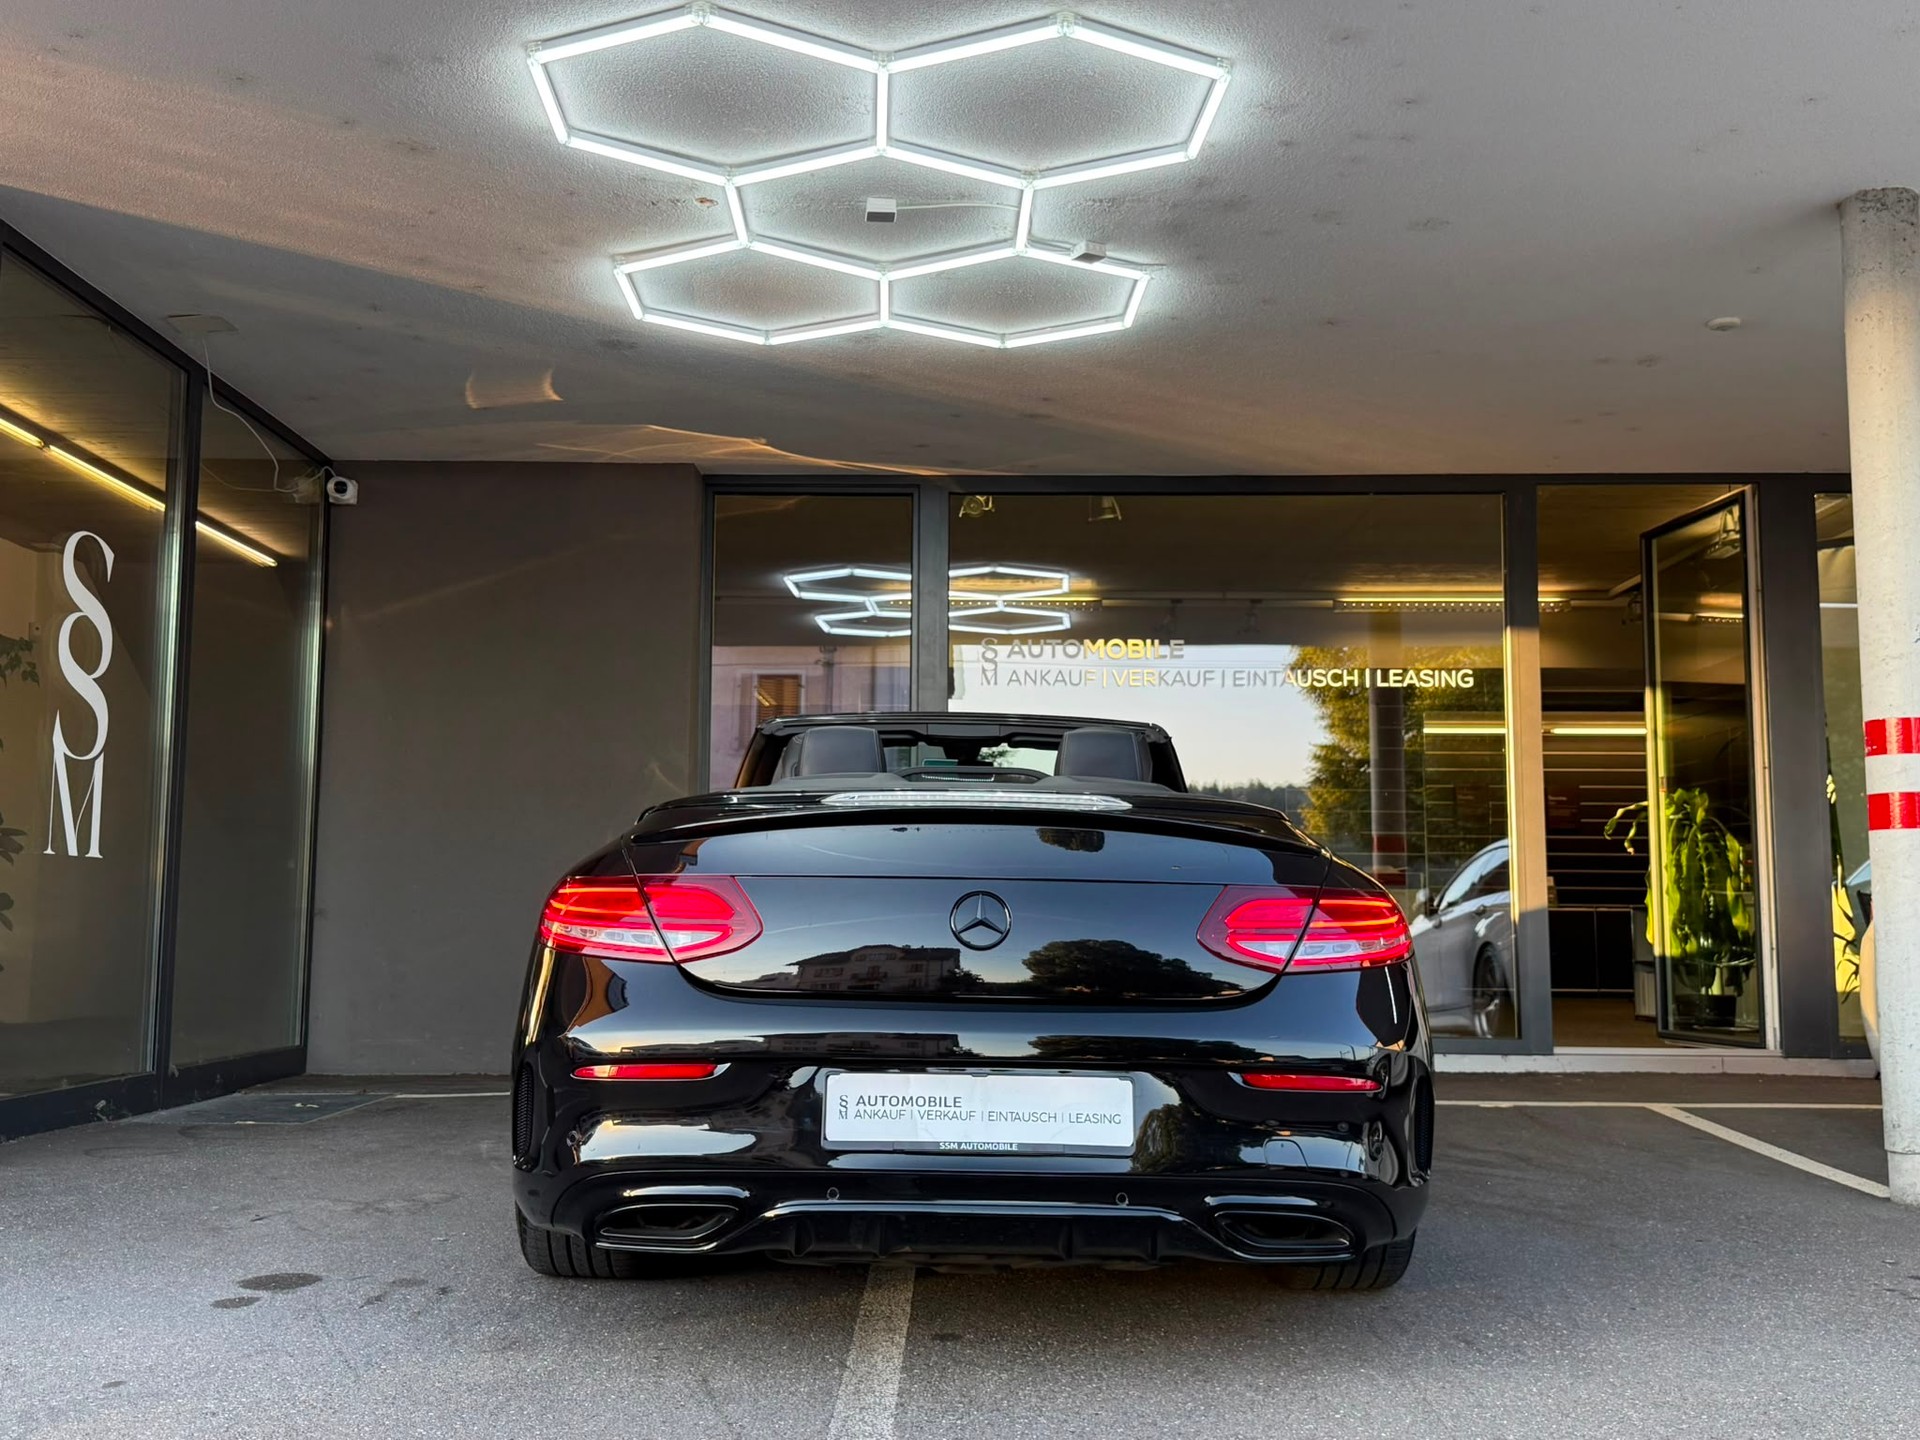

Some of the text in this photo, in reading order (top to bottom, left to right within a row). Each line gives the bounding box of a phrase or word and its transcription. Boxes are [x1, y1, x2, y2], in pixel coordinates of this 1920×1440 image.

[1007, 638, 1185, 660] AUTOMOBILE
[1007, 668, 1475, 689] ANKAUF VERKAUF EINTAUSCH LEASING
[855, 1095, 963, 1108] AUTOMOBILE
[853, 1109, 1122, 1125] ANKAUF VERKAUF EINTAUSCH LEASING
[939, 1142, 1019, 1151] SSM AUTOMOBILE
